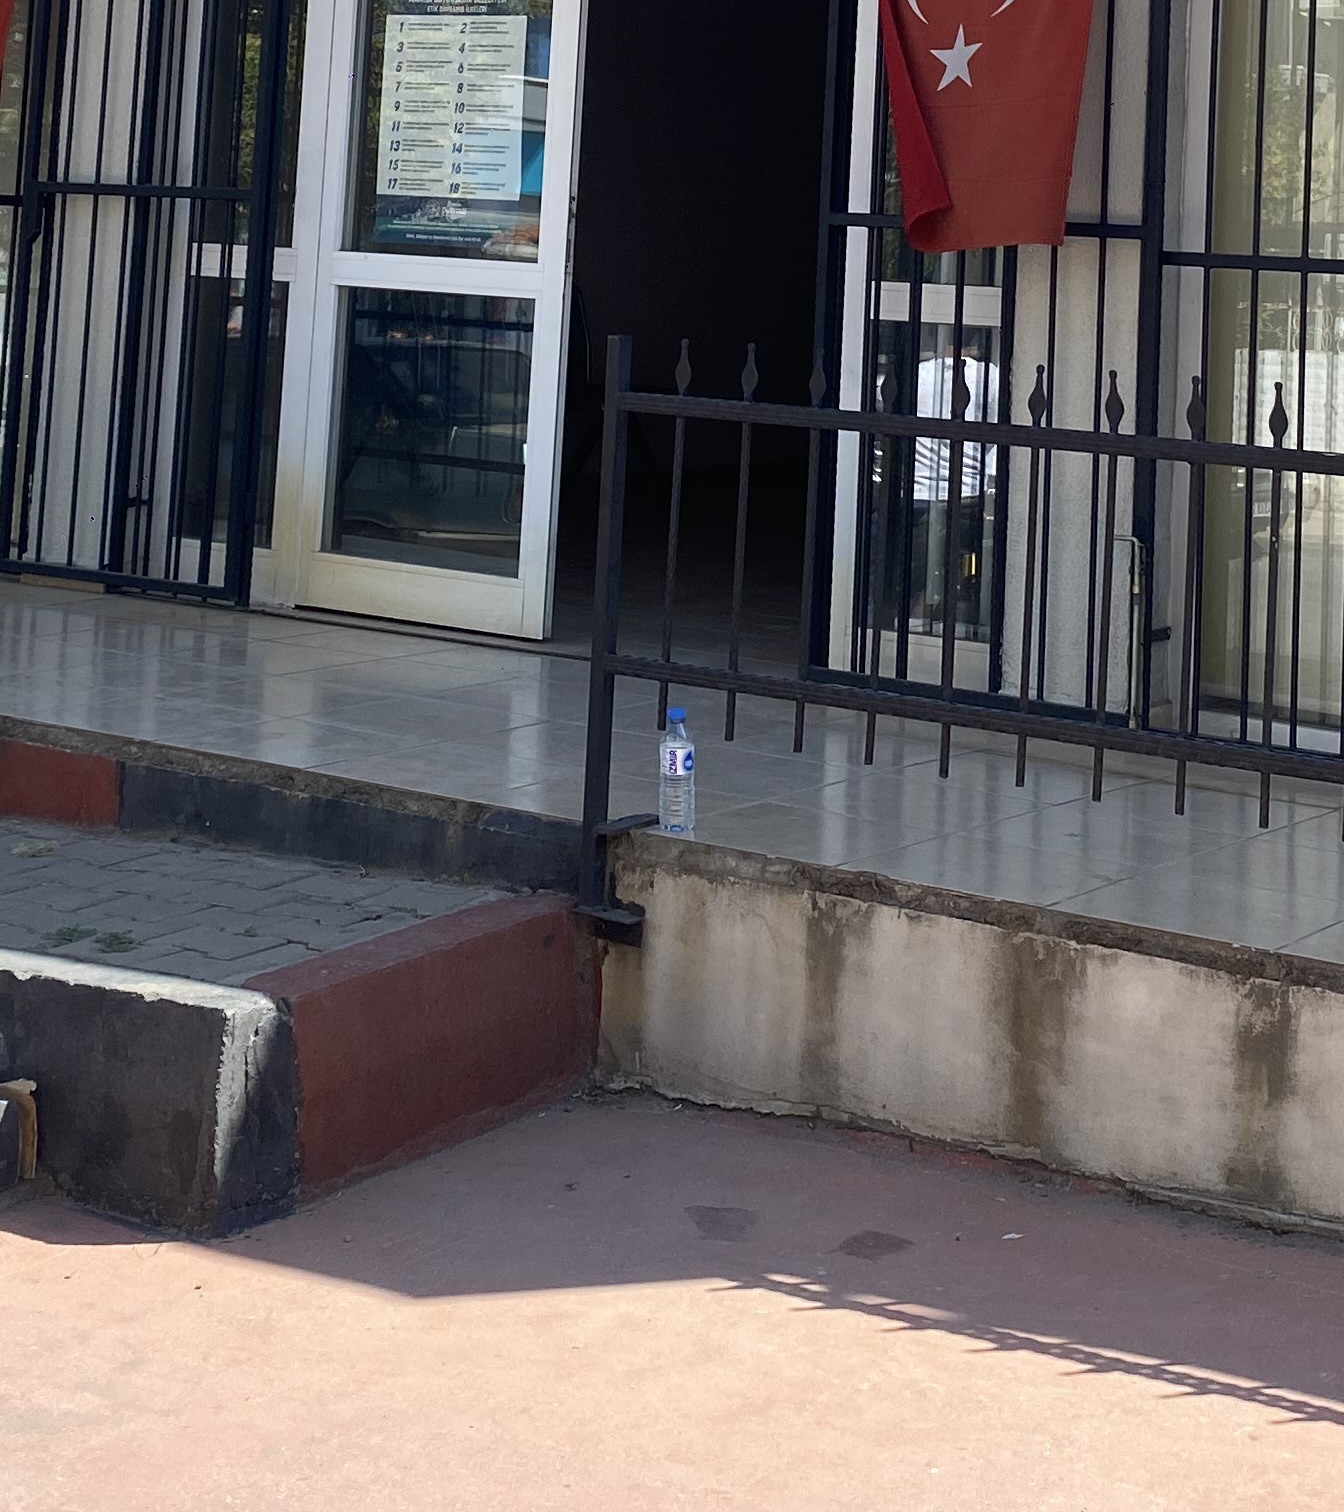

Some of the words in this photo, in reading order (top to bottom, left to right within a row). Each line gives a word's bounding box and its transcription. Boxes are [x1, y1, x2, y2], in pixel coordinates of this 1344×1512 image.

[400, 22, 404, 32] 1
[460, 23, 467, 33] 2
[397, 42, 403, 52] 3
[459, 43, 466, 53] 4
[396, 62, 403, 72] 5
[458, 63, 463, 73] 6
[395, 82, 401, 92] 7
[457, 83, 463, 93] 8
[394, 101, 400, 111] 9
[454, 102, 464, 113] 10
[392, 121, 400, 132] 11
[454, 123, 464, 133] 12
[390, 140, 400, 151] 13
[452, 143, 462, 153] 14
[388, 159, 399, 170] 15
[451, 163, 461, 174] 16
[388, 178, 398, 189] 17
